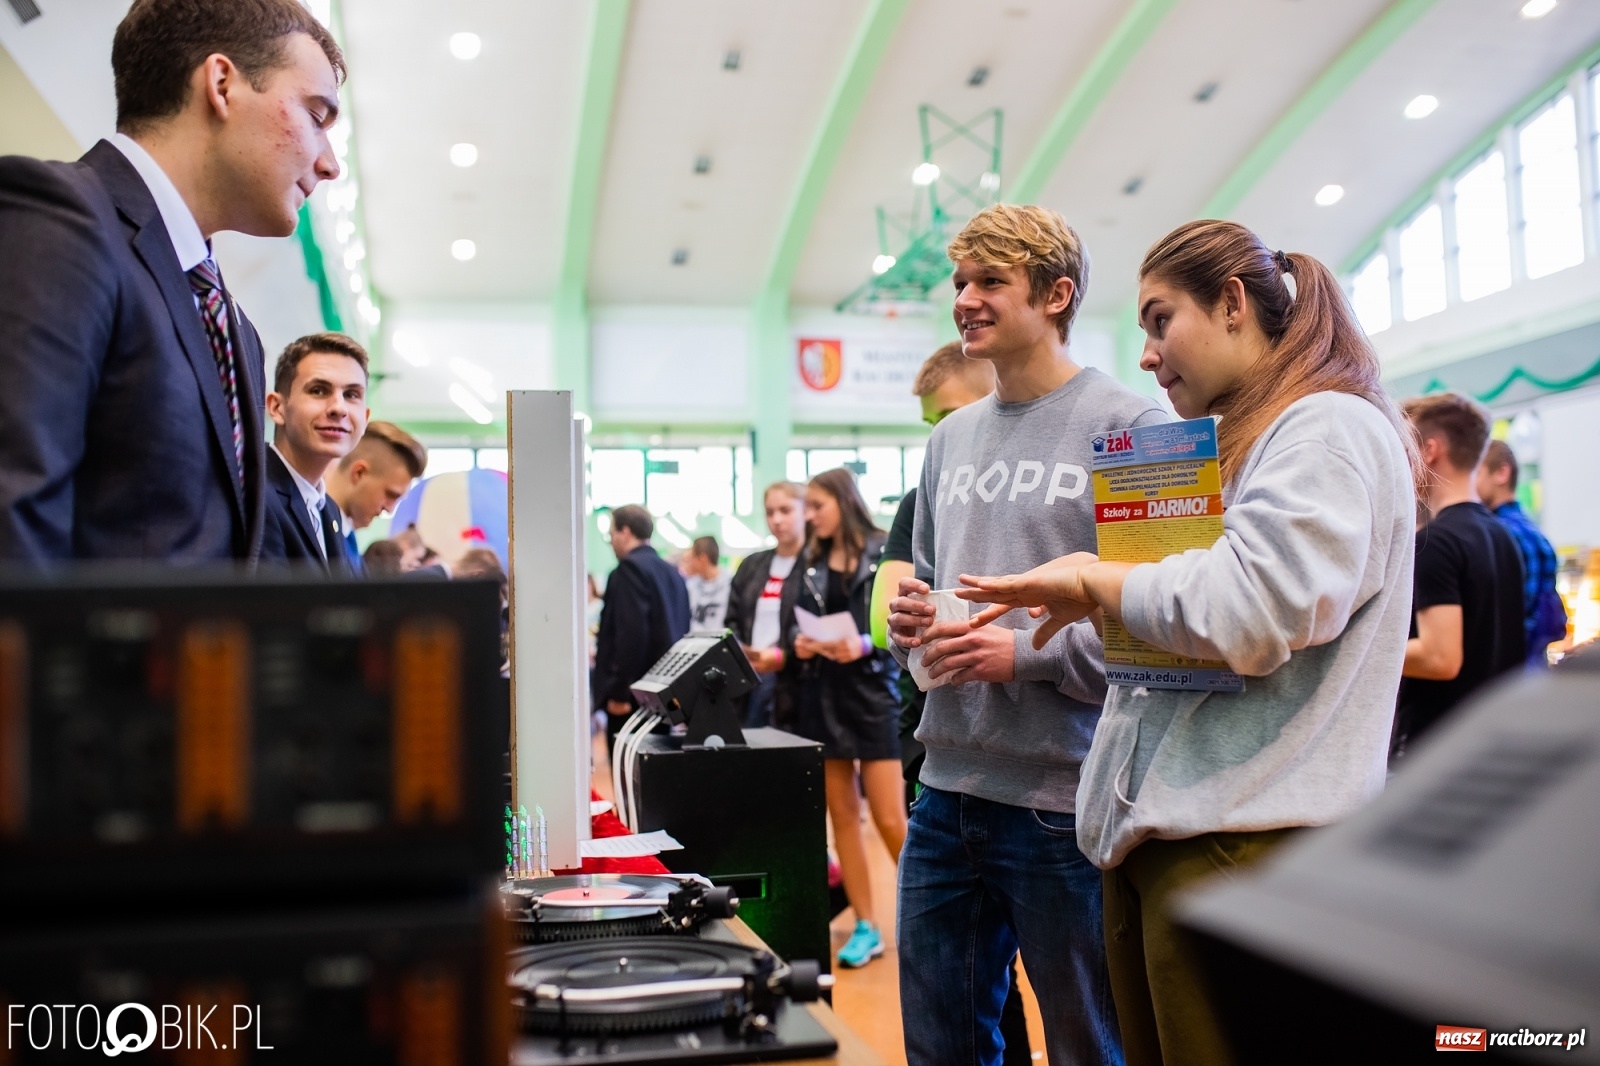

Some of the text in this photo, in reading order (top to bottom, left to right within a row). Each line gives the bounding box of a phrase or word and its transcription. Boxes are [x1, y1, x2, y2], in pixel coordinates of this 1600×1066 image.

[1106, 430, 1134, 453] żak
[1103, 507, 1131, 520] Szkoły
[1106, 670, 1192, 686] www.zak.edu.pl
